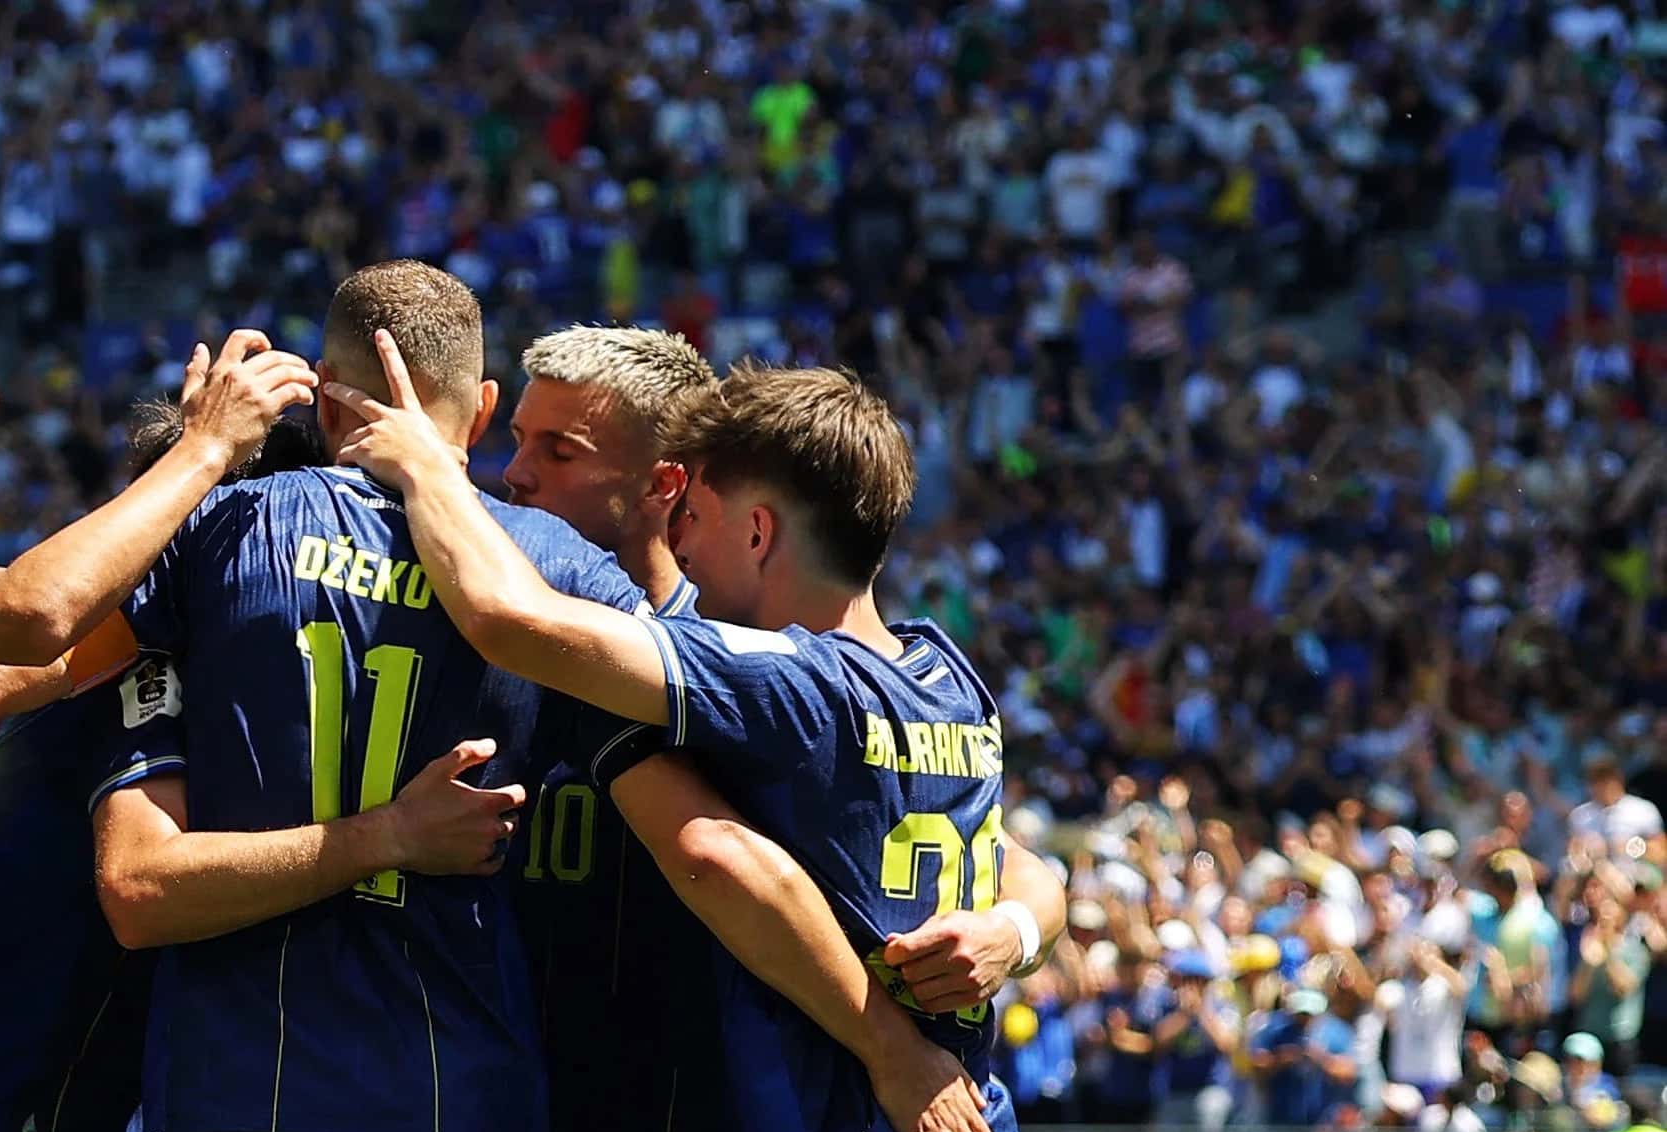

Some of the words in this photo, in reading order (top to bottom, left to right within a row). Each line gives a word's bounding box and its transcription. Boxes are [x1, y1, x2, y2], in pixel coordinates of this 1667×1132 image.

[295, 534, 433, 610] DŽEKO
[296, 621, 423, 907] 11
[524, 784, 597, 884] 10
